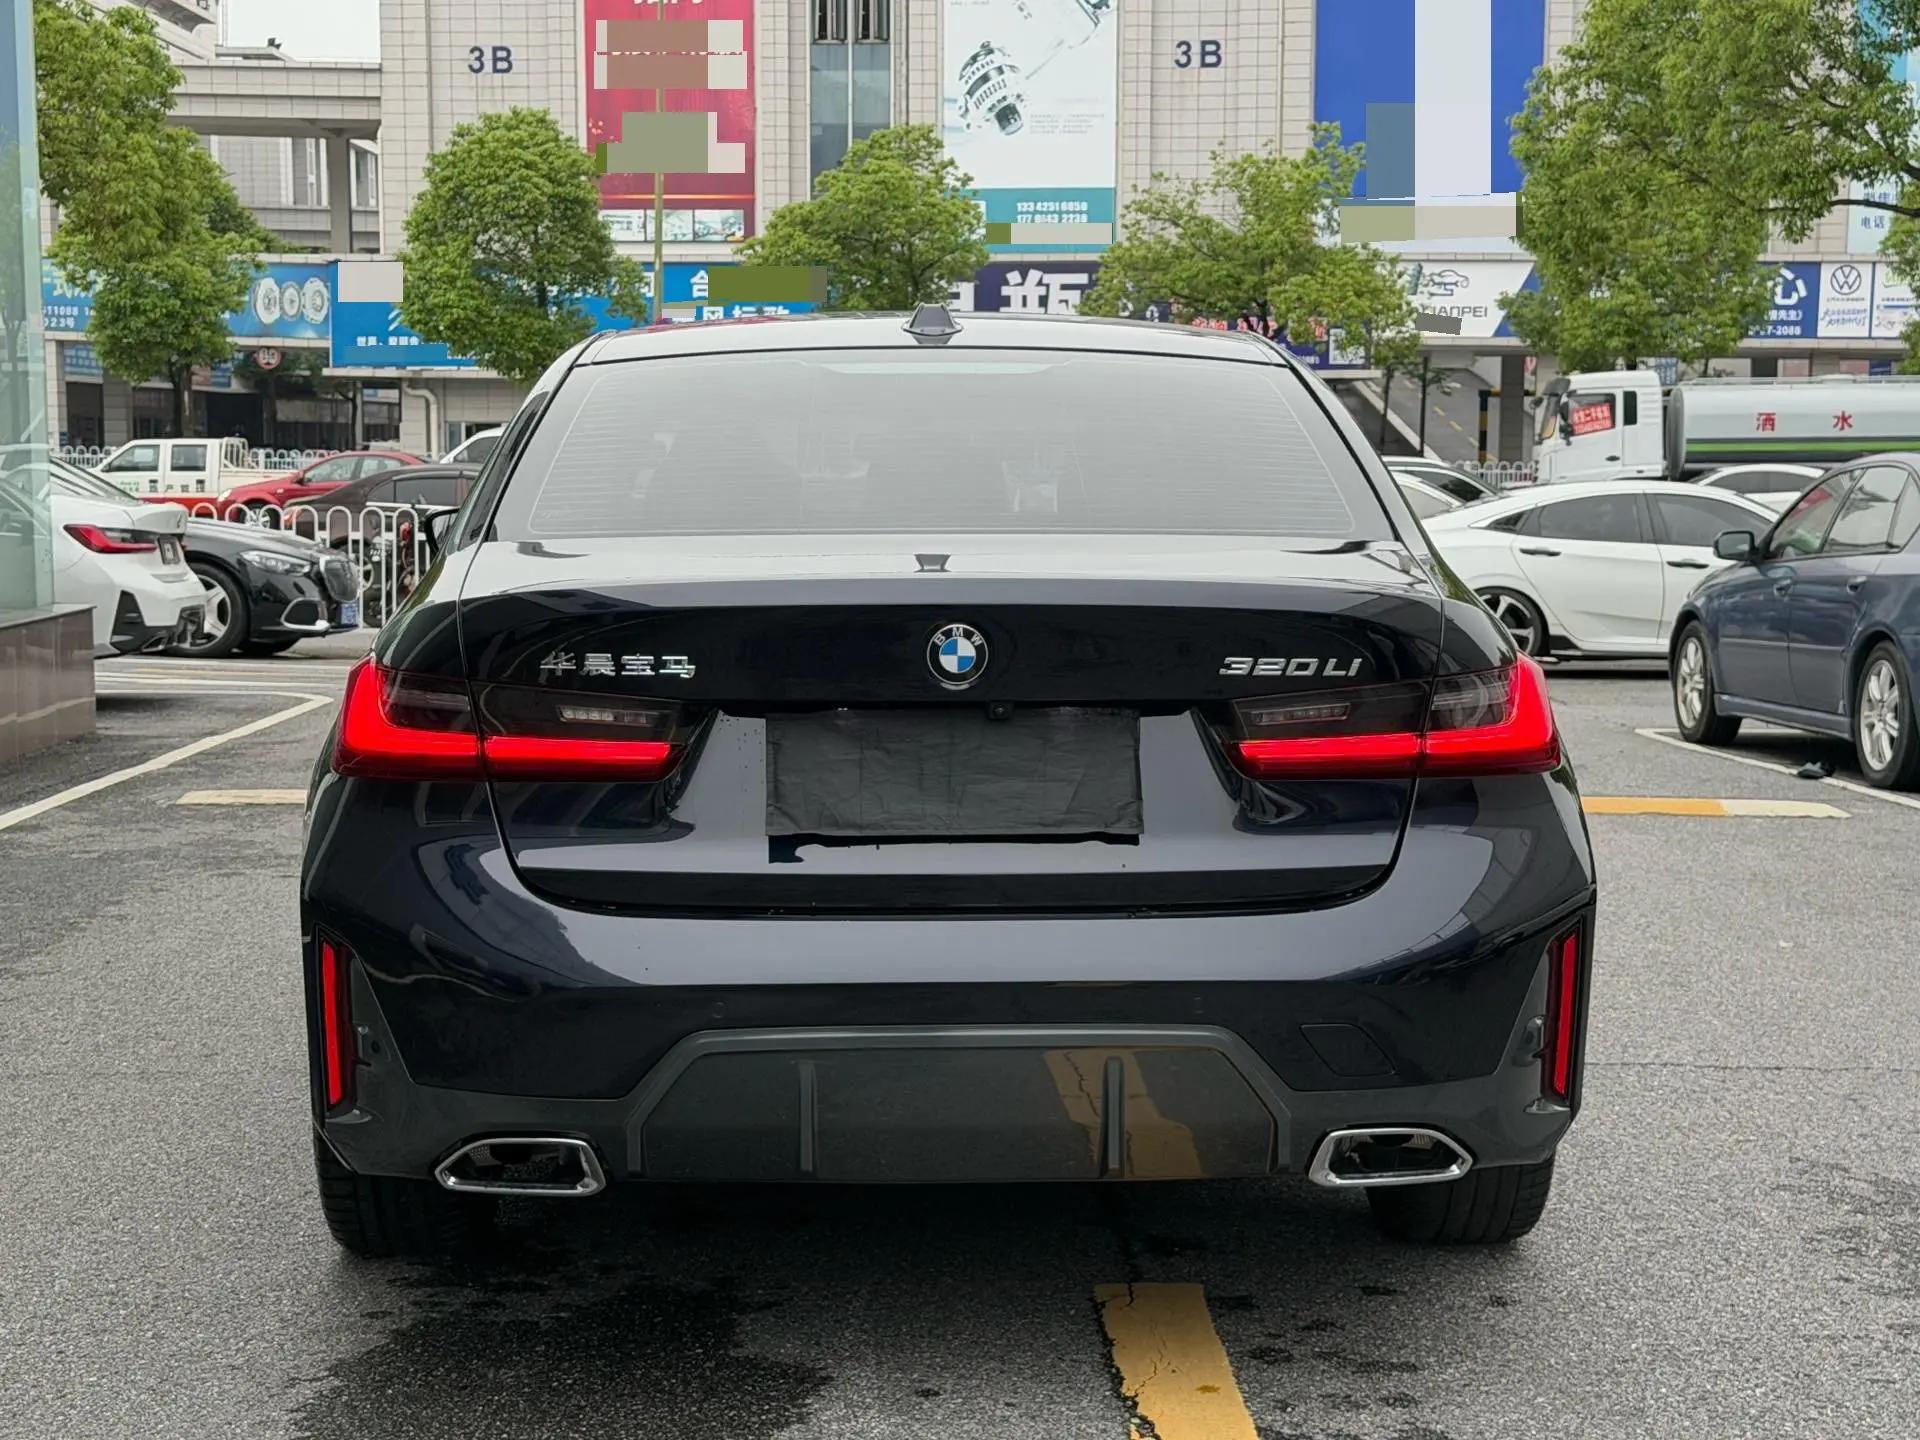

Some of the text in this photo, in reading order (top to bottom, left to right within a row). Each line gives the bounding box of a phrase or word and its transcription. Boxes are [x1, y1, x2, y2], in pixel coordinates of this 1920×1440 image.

[468, 46, 513, 74] 3B
[1174, 40, 1222, 69] 3B
[538, 652, 697, 681] 华晨宝马
